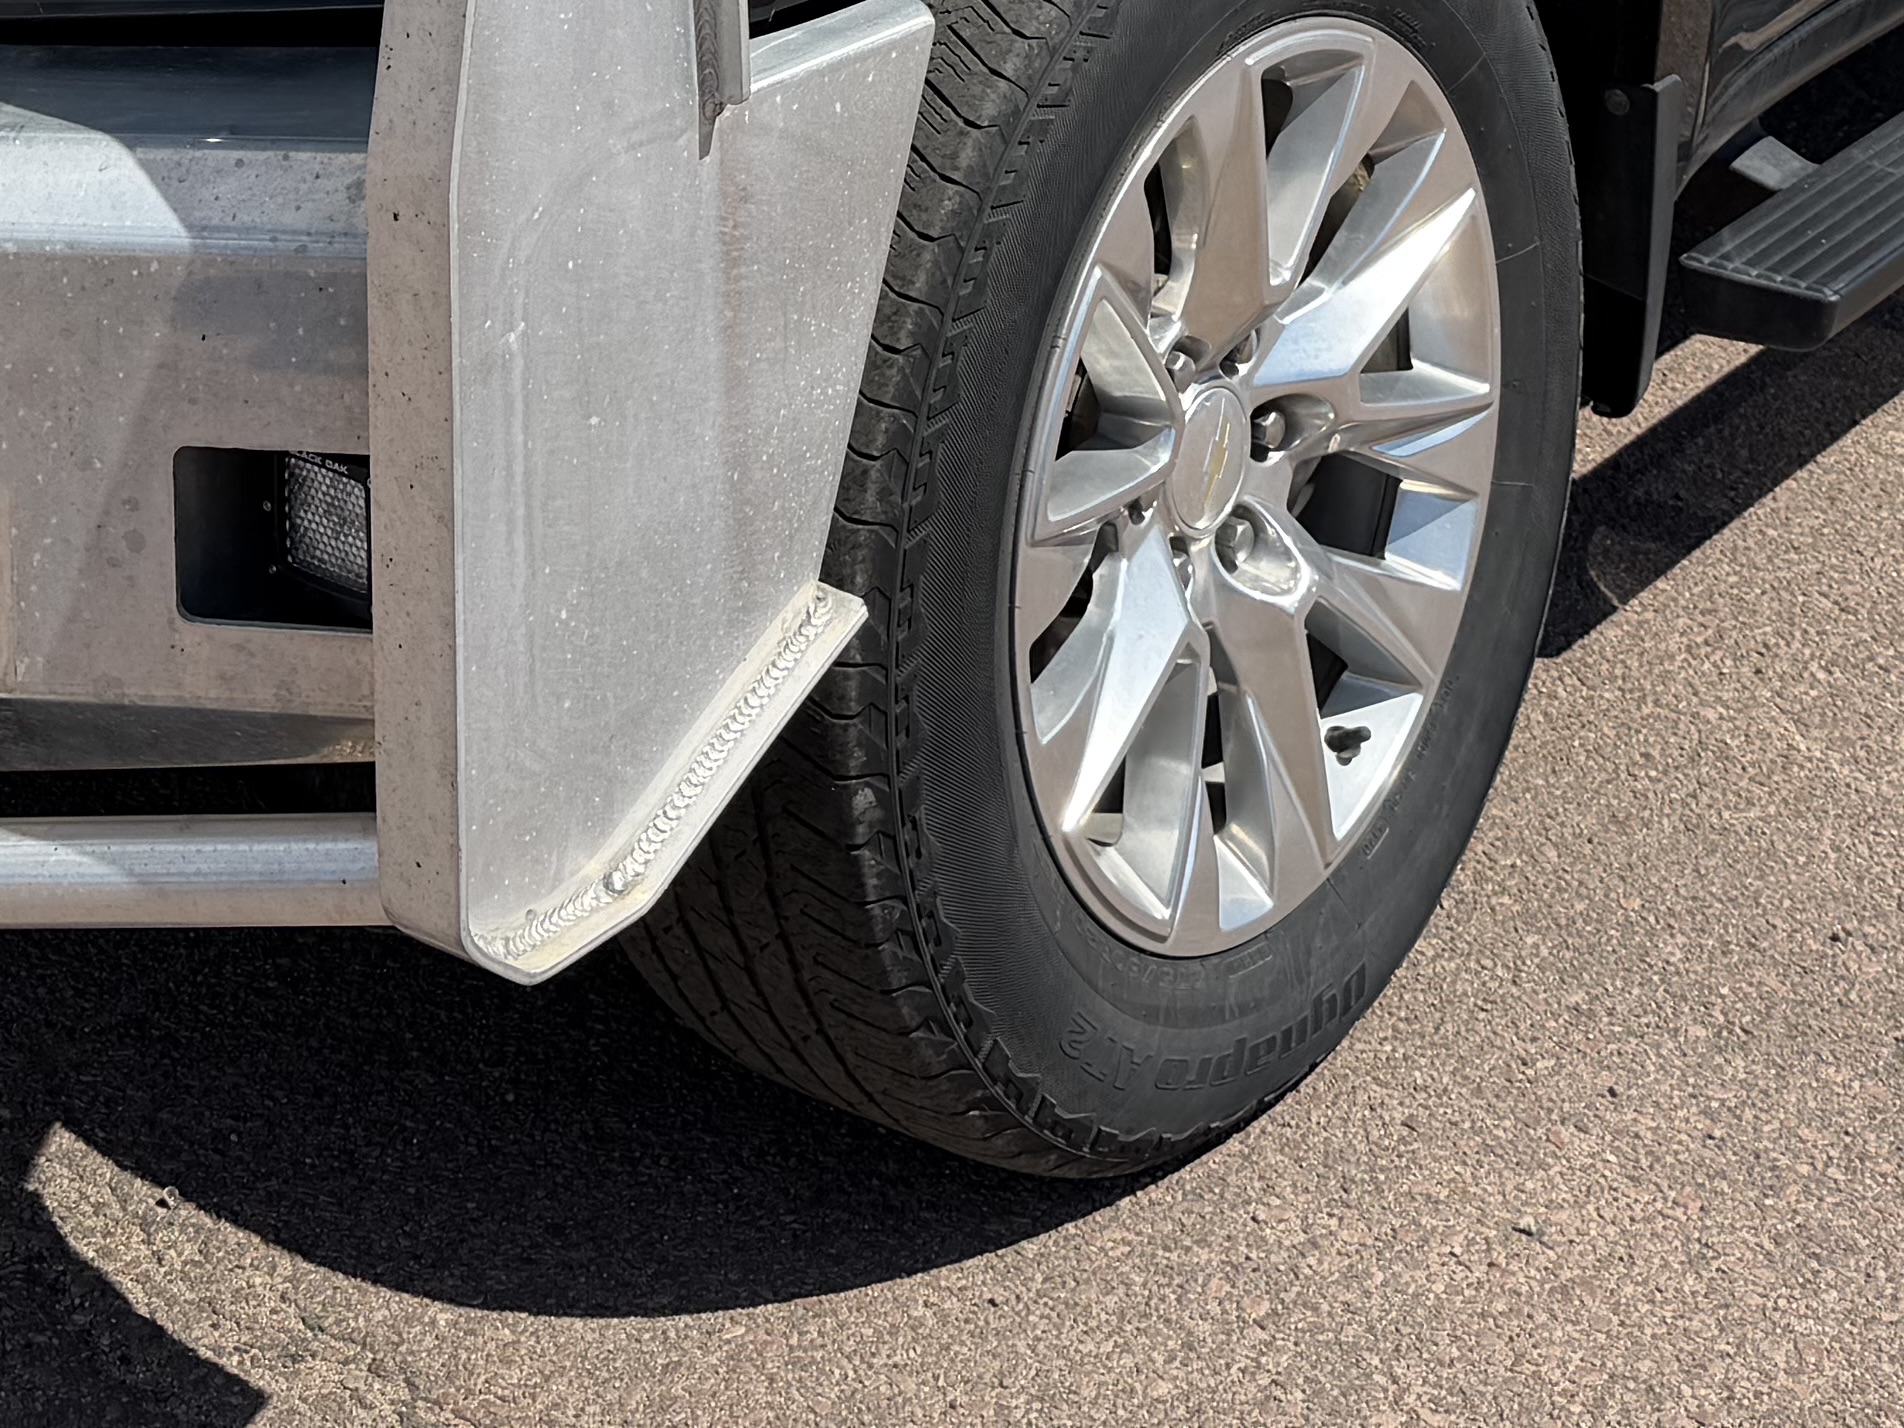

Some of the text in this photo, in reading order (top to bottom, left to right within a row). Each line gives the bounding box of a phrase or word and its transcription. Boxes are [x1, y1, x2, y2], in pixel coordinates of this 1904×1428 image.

[325, 459, 349, 475] OAK
[1057, 959, 1368, 1093] Dynapro AT2
